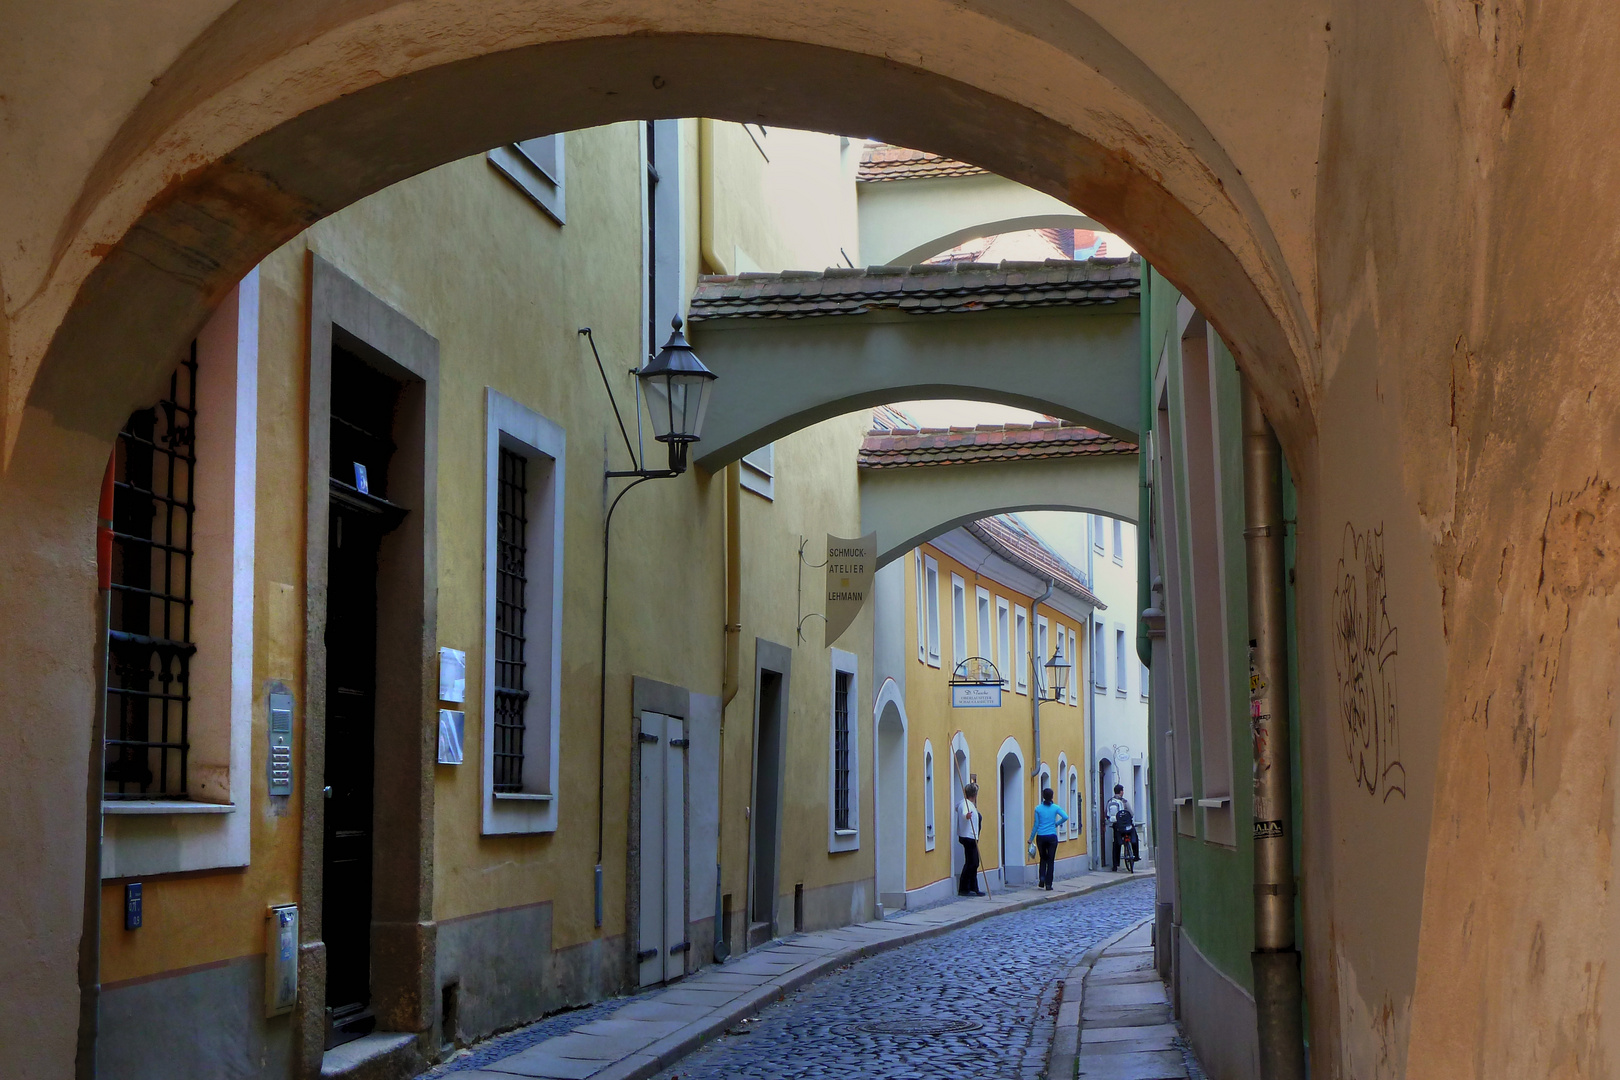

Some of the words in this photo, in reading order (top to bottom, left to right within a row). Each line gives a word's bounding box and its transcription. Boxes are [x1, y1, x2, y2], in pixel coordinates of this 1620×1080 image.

[829, 548, 867, 558] SCHMUCK-
[828, 564, 864, 574] ATELIER
[828, 591, 863, 601] LEHMANN
